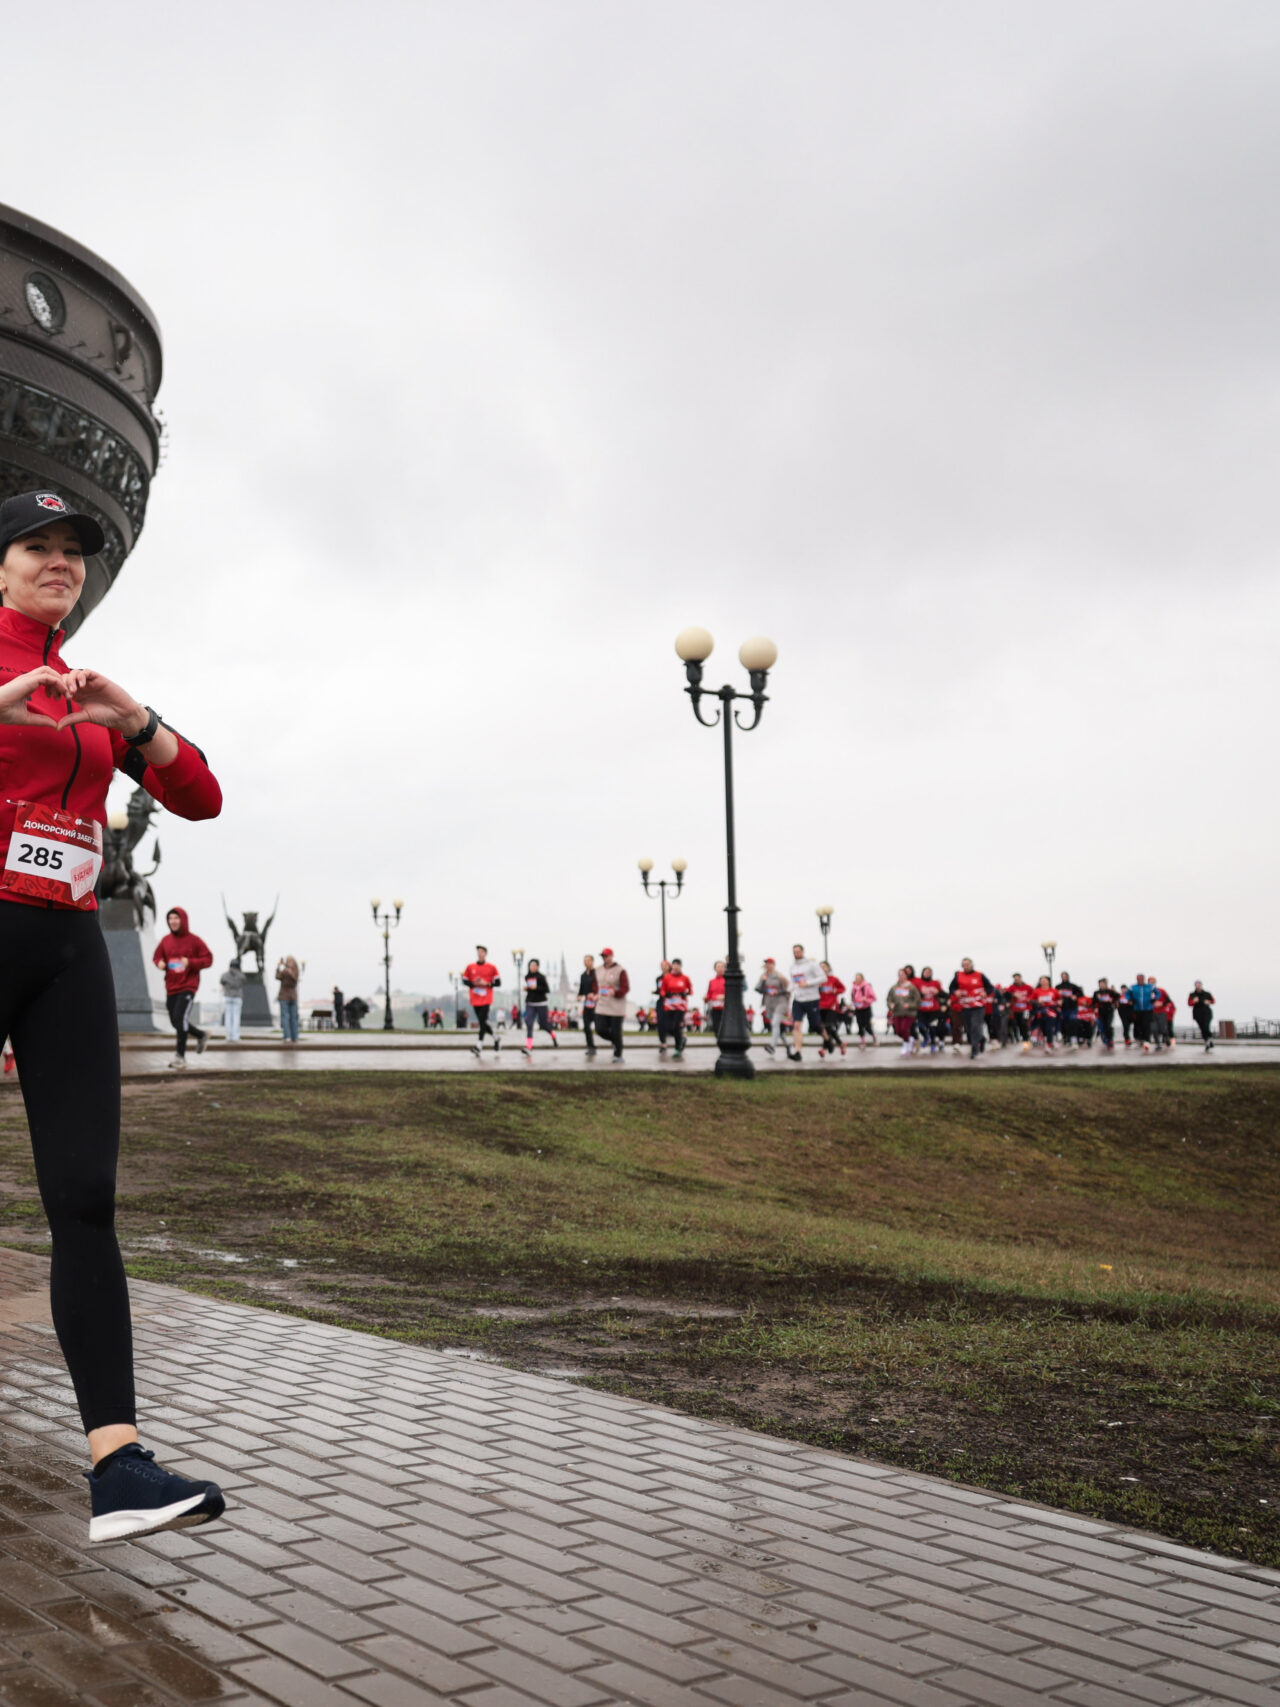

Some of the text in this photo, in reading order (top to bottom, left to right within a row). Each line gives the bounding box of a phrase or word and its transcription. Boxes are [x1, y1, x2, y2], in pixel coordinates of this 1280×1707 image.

[23, 820, 76, 838] ДОНОРСКИЙ
[76, 832, 93, 843] ЗАБЕГ
[18, 844, 63, 870] 285
